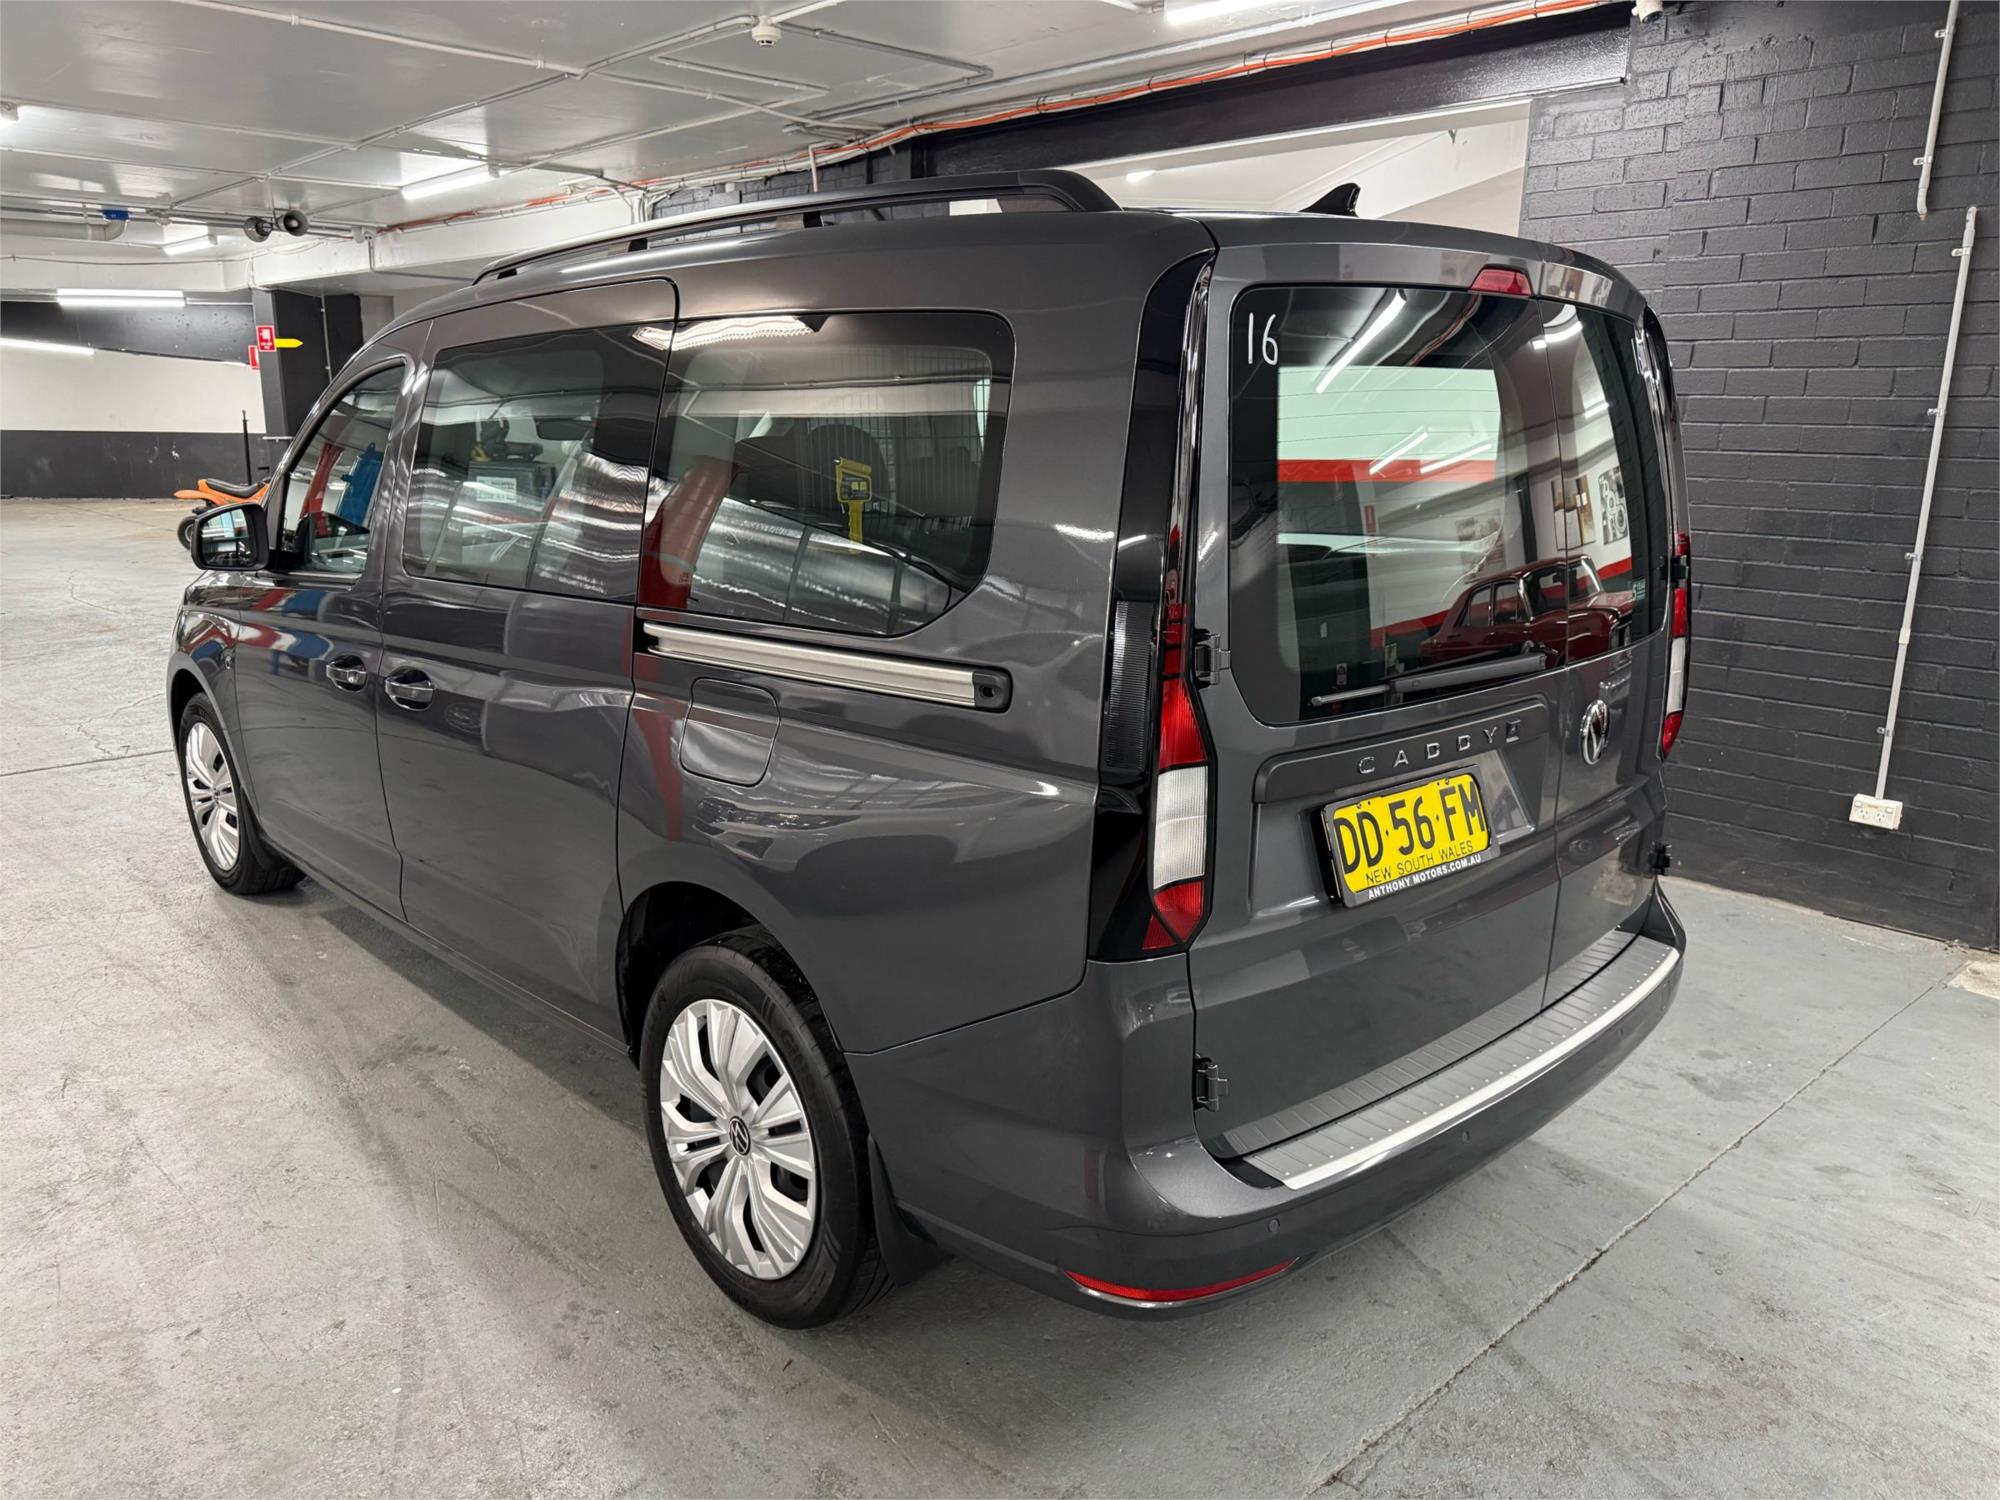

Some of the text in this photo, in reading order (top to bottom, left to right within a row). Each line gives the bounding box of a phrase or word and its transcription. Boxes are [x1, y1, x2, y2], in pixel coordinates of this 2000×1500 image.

[1248, 312, 1278, 366] 16
[1358, 727, 1497, 774] CADDY
[1366, 840, 1473, 886] NEW SOUTH WALES
[1368, 854, 1482, 900] ANTHONY MOTORS.COM.AU
